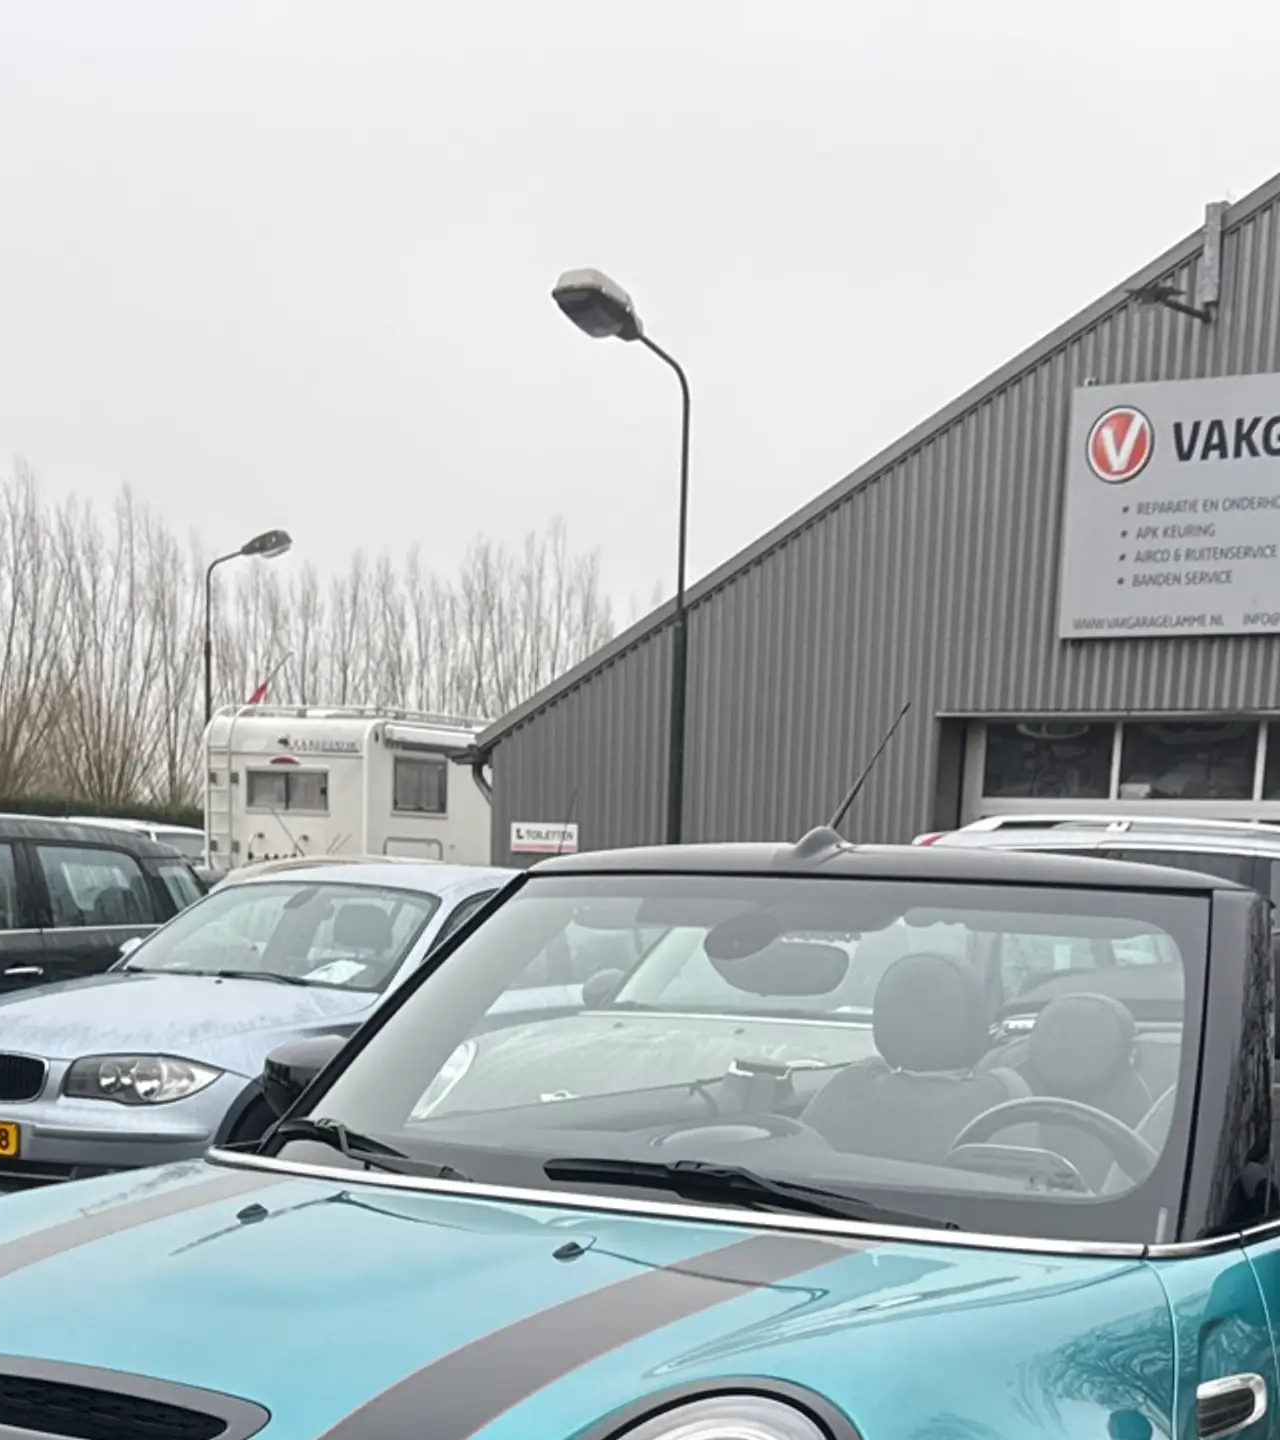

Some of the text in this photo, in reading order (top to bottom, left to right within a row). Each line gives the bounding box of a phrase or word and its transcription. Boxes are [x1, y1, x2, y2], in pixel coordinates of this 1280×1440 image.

[1136, 497, 1199, 515] REPARATIE
[1202, 497, 1219, 513] EN
[1136, 523, 1216, 540] APK KEURING
[1134, 549, 1170, 564] AIRCO
[1184, 544, 1278, 562] RUITENSERVICE
[1132, 570, 1233, 587] BANDEN SERVICE
